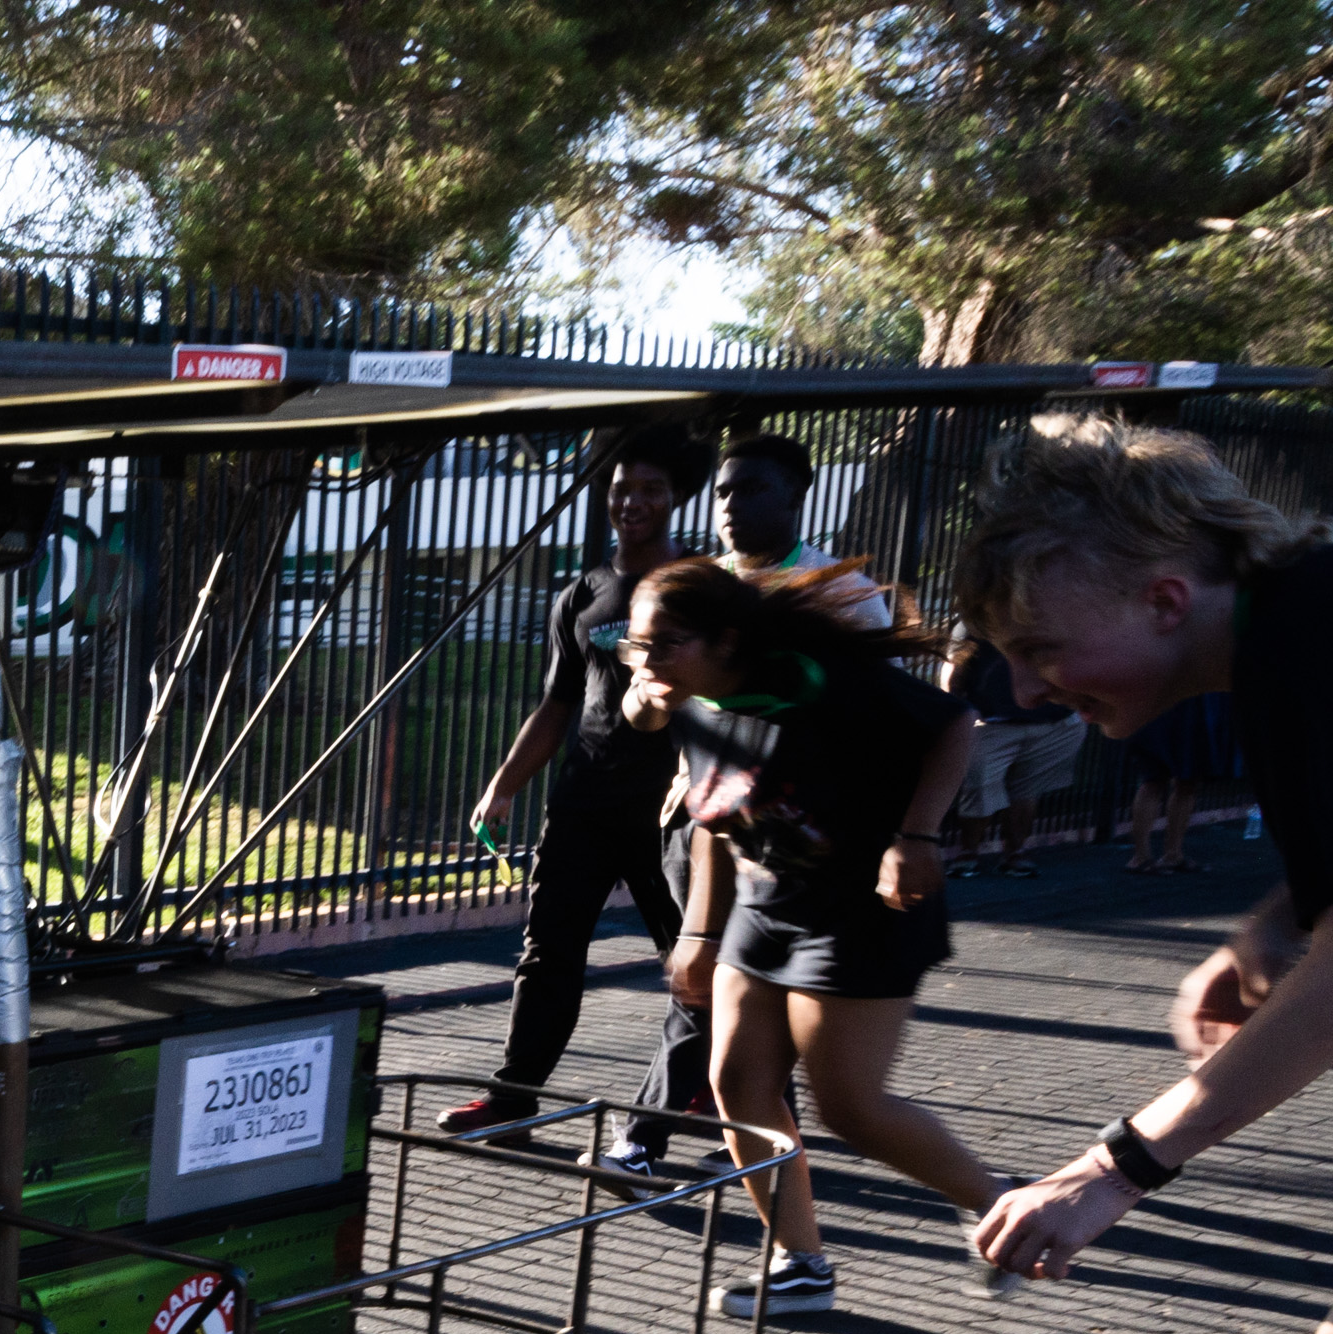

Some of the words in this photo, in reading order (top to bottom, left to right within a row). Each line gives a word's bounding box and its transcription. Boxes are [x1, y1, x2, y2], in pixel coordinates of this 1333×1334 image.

[197, 355, 261, 379] DANGER
[358, 359, 389, 380] HIGH
[393, 358, 445, 380] VOLTAGE
[210, 1124, 239, 1147] JUL
[244, 1110, 308, 1139] 31,2023
[153, 1276, 236, 1332] DANGR
